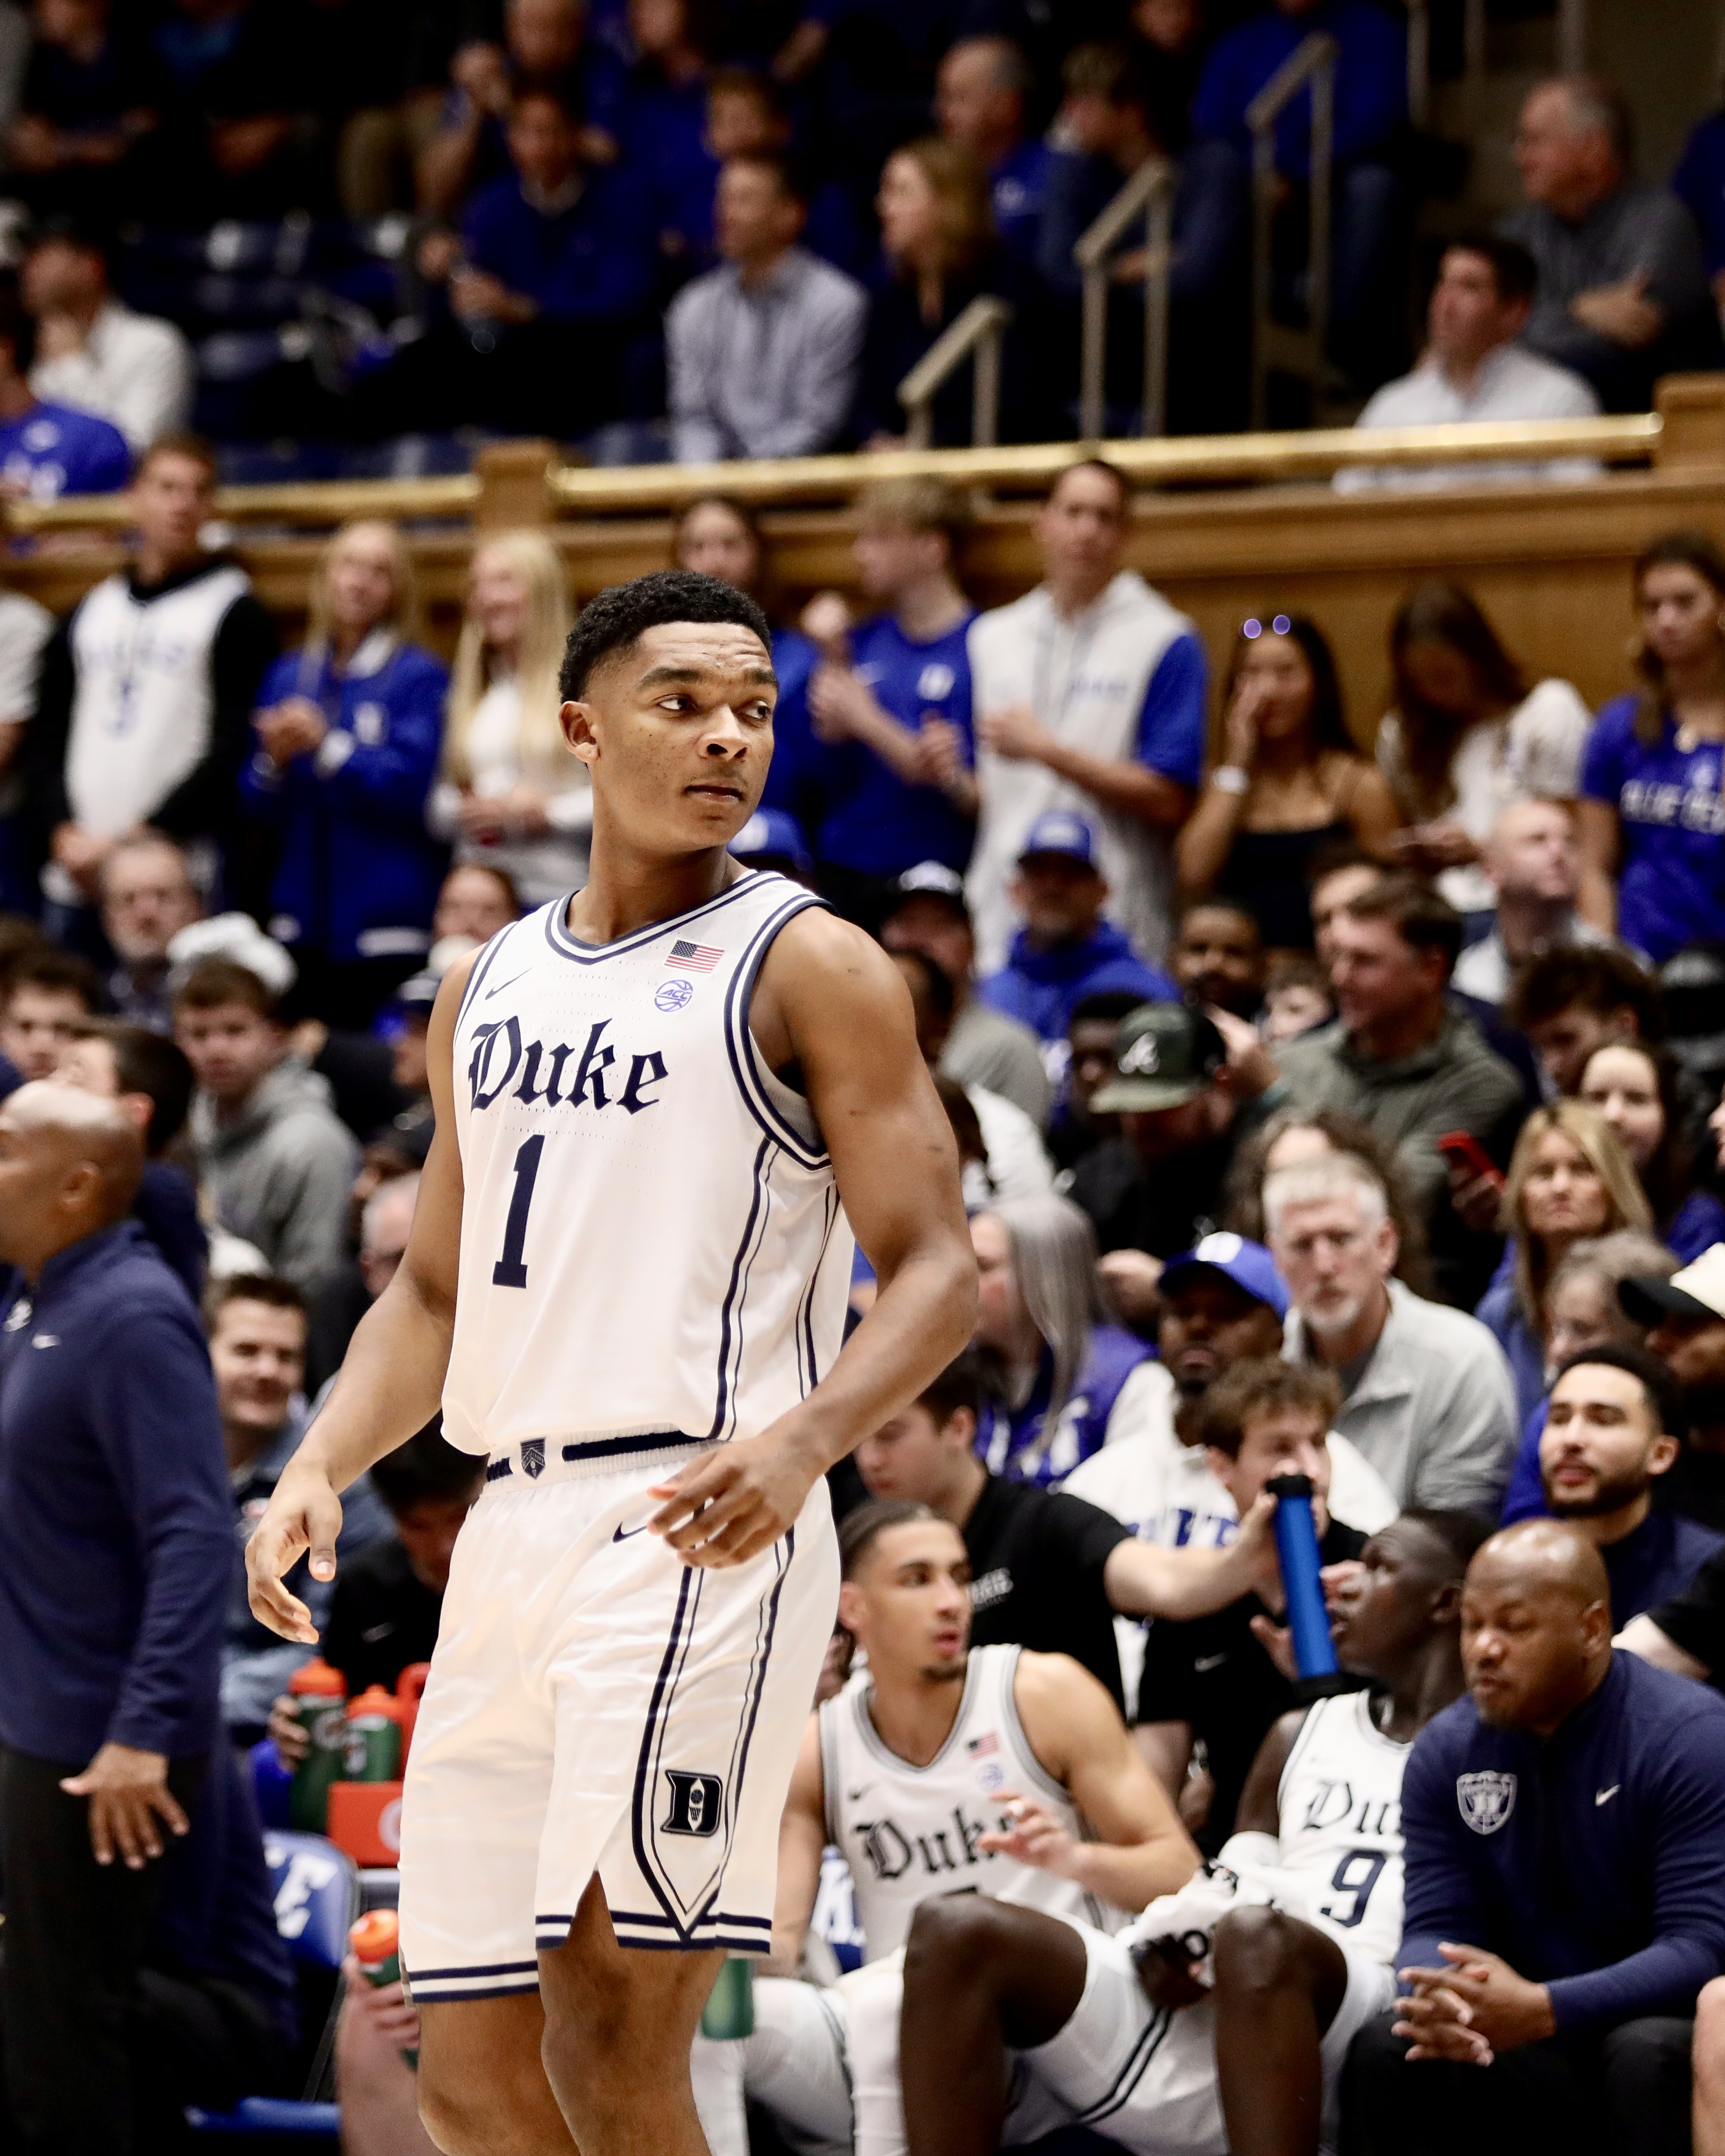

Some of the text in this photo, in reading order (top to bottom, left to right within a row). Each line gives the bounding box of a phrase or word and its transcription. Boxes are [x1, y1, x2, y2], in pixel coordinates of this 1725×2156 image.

[660, 989, 693, 999] ACC
[468, 1015, 668, 1115] Duke
[493, 1134, 545, 1289] 1
[1302, 1781, 1401, 1835] Du
[1321, 1848, 1387, 1928] 9
